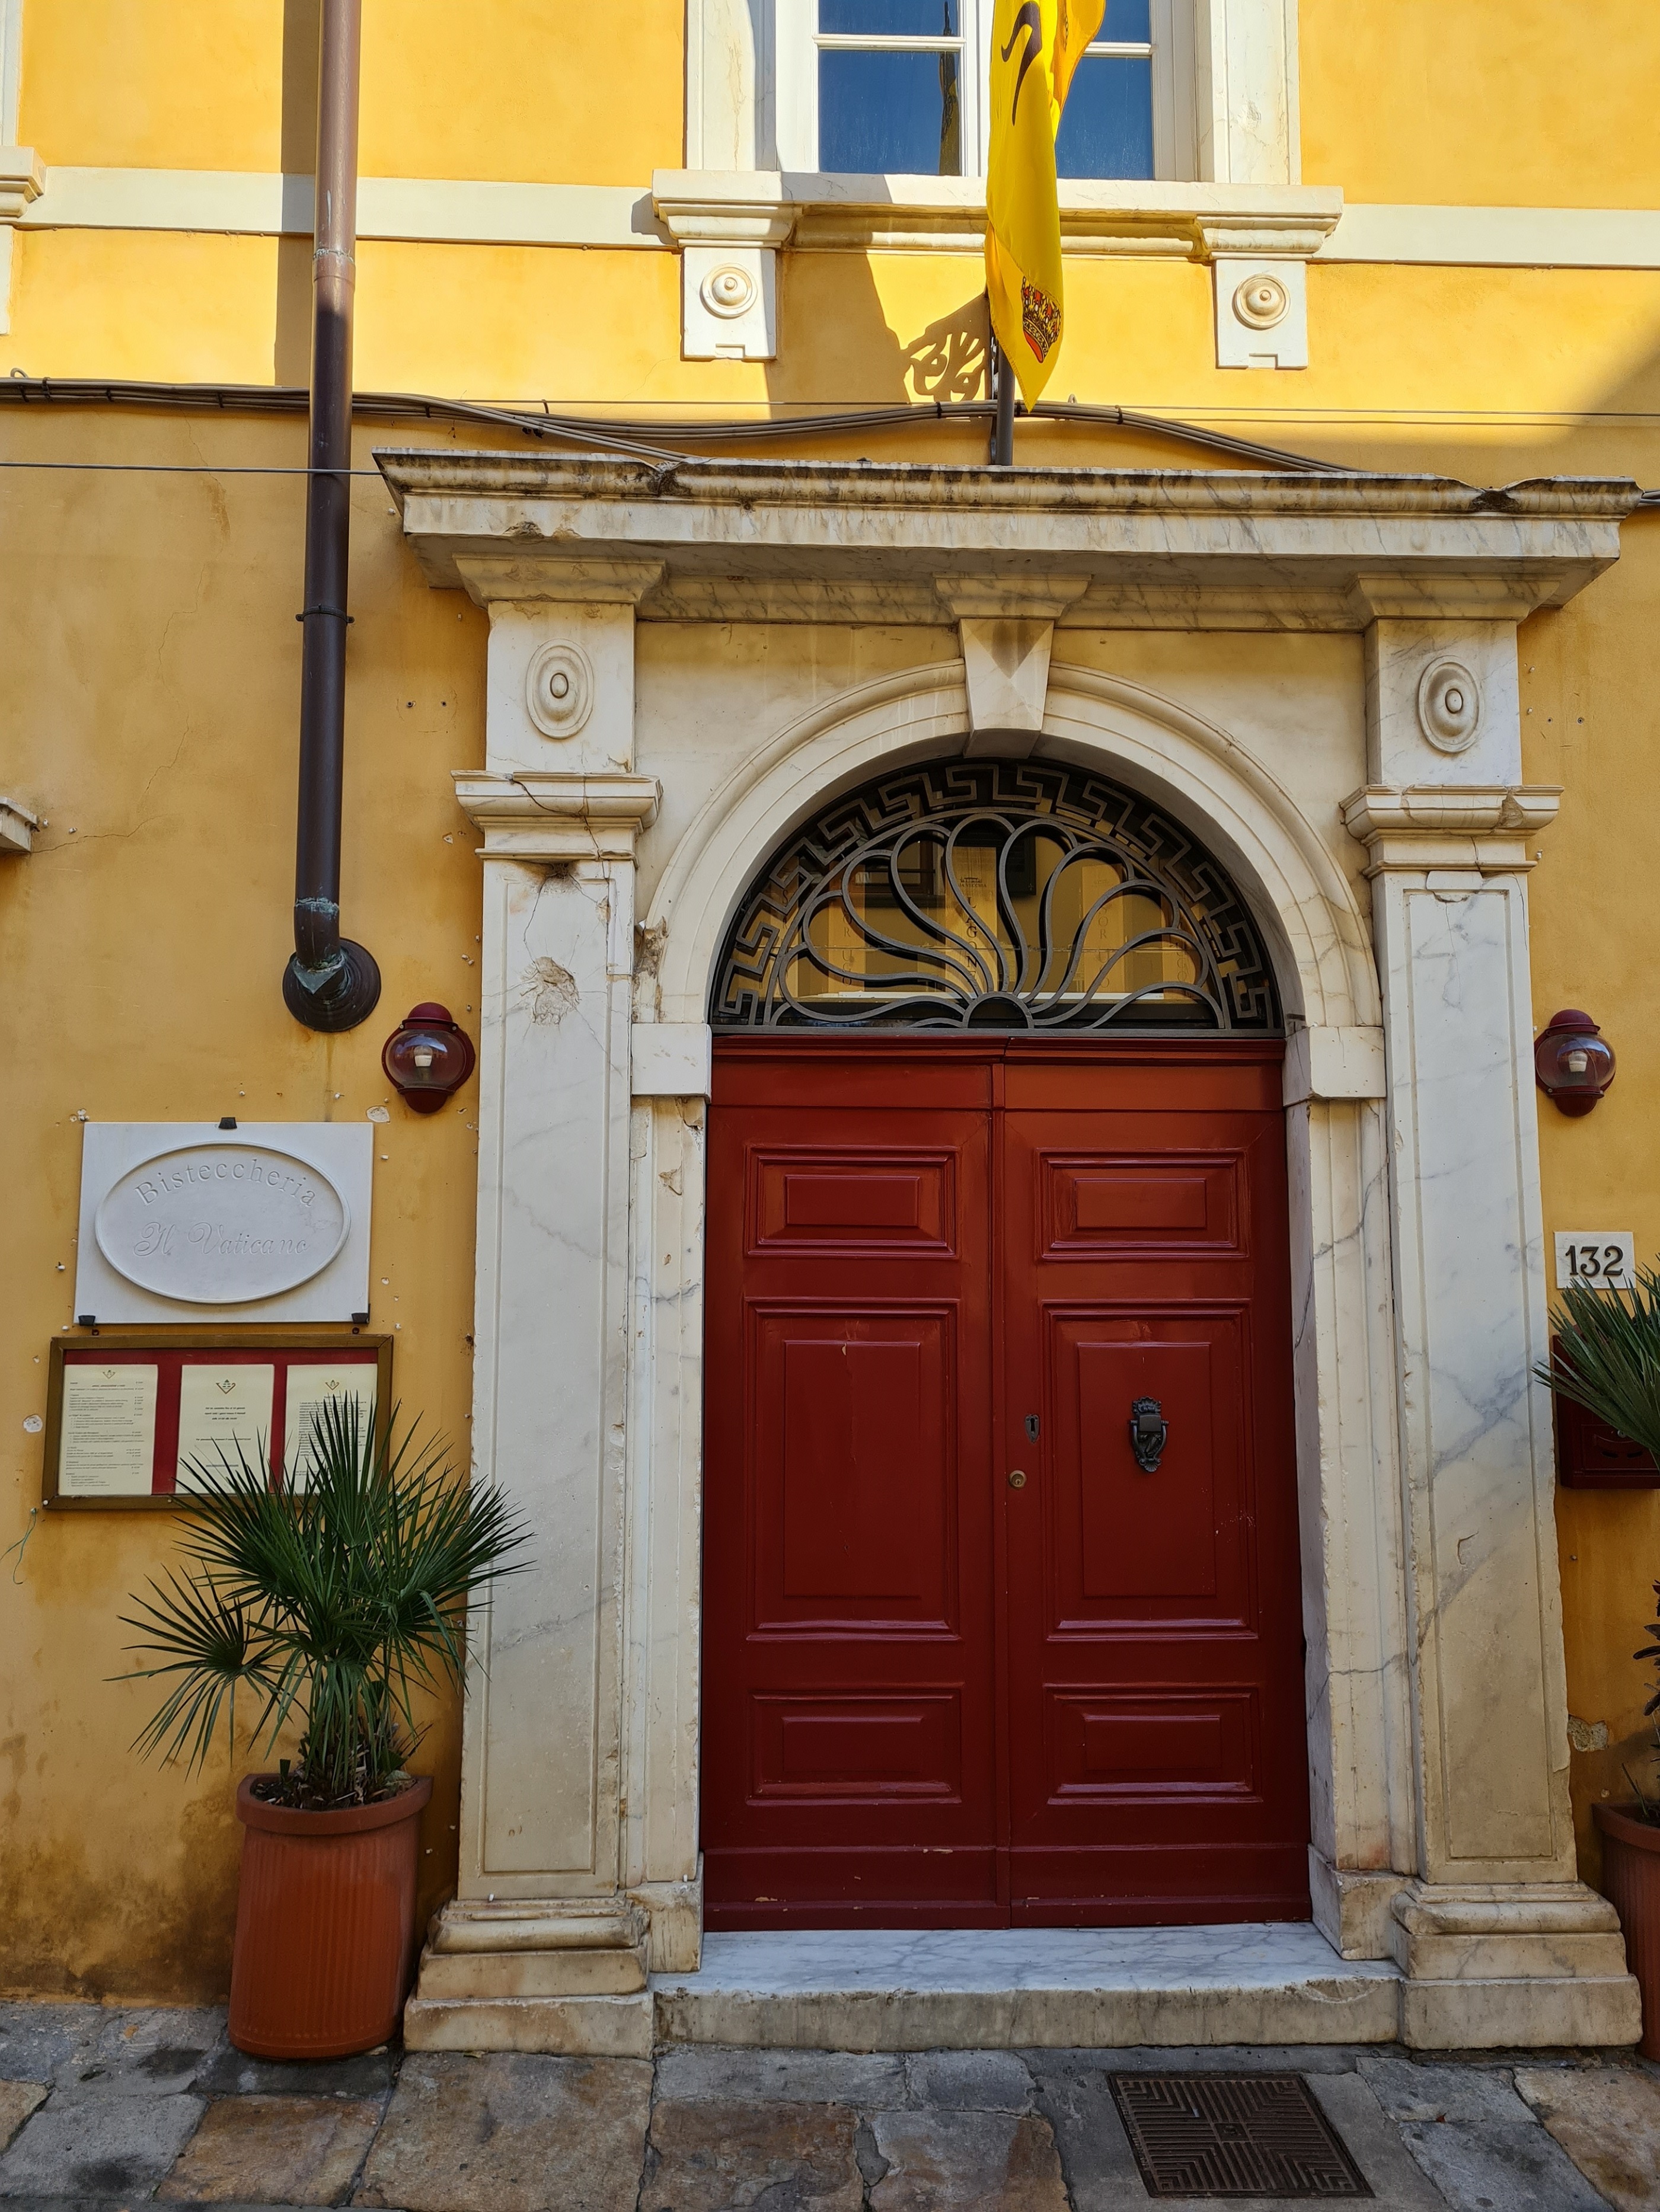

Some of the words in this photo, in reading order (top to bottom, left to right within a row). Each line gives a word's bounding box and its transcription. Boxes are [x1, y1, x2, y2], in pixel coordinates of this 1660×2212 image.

[1099, 951, 1109, 988] UO
[133, 1159, 317, 1207] Bisteccheria
[187, 1222, 310, 1255] Vaticano
[1565, 1245, 1624, 1277] 132
